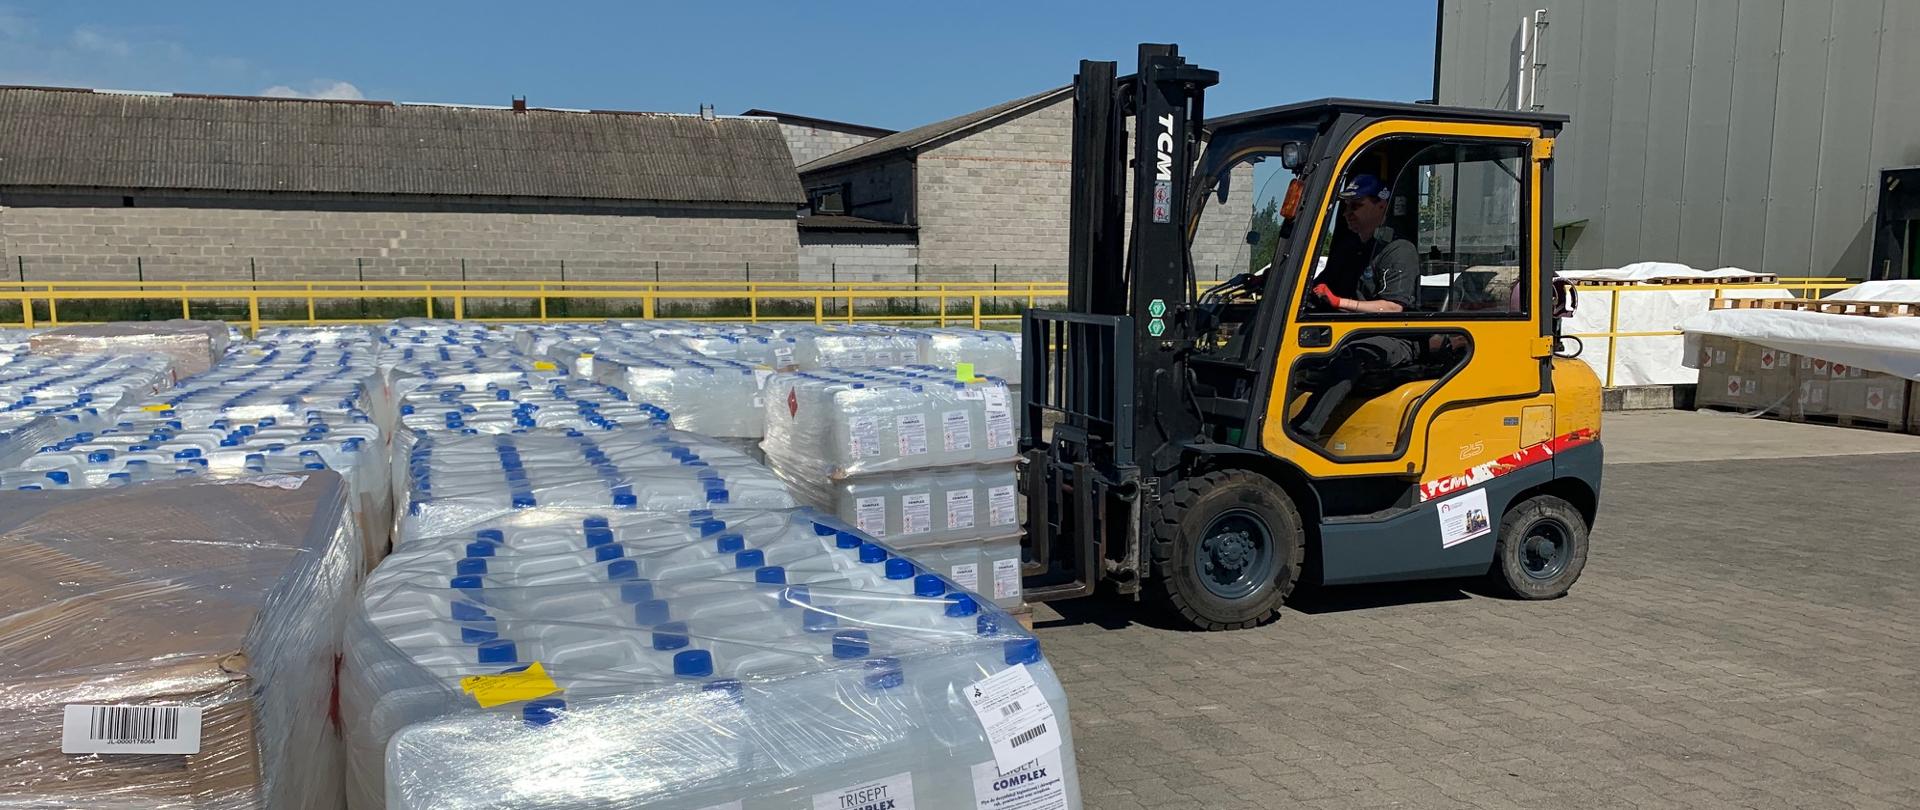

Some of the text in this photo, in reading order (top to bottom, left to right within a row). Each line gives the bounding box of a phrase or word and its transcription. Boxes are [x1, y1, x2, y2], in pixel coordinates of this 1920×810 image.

[1157, 113, 1173, 180] TCM
[1459, 440, 1484, 460] 25
[993, 768, 1047, 791] COMPLEX
[839, 785, 887, 808] TRISEPT
